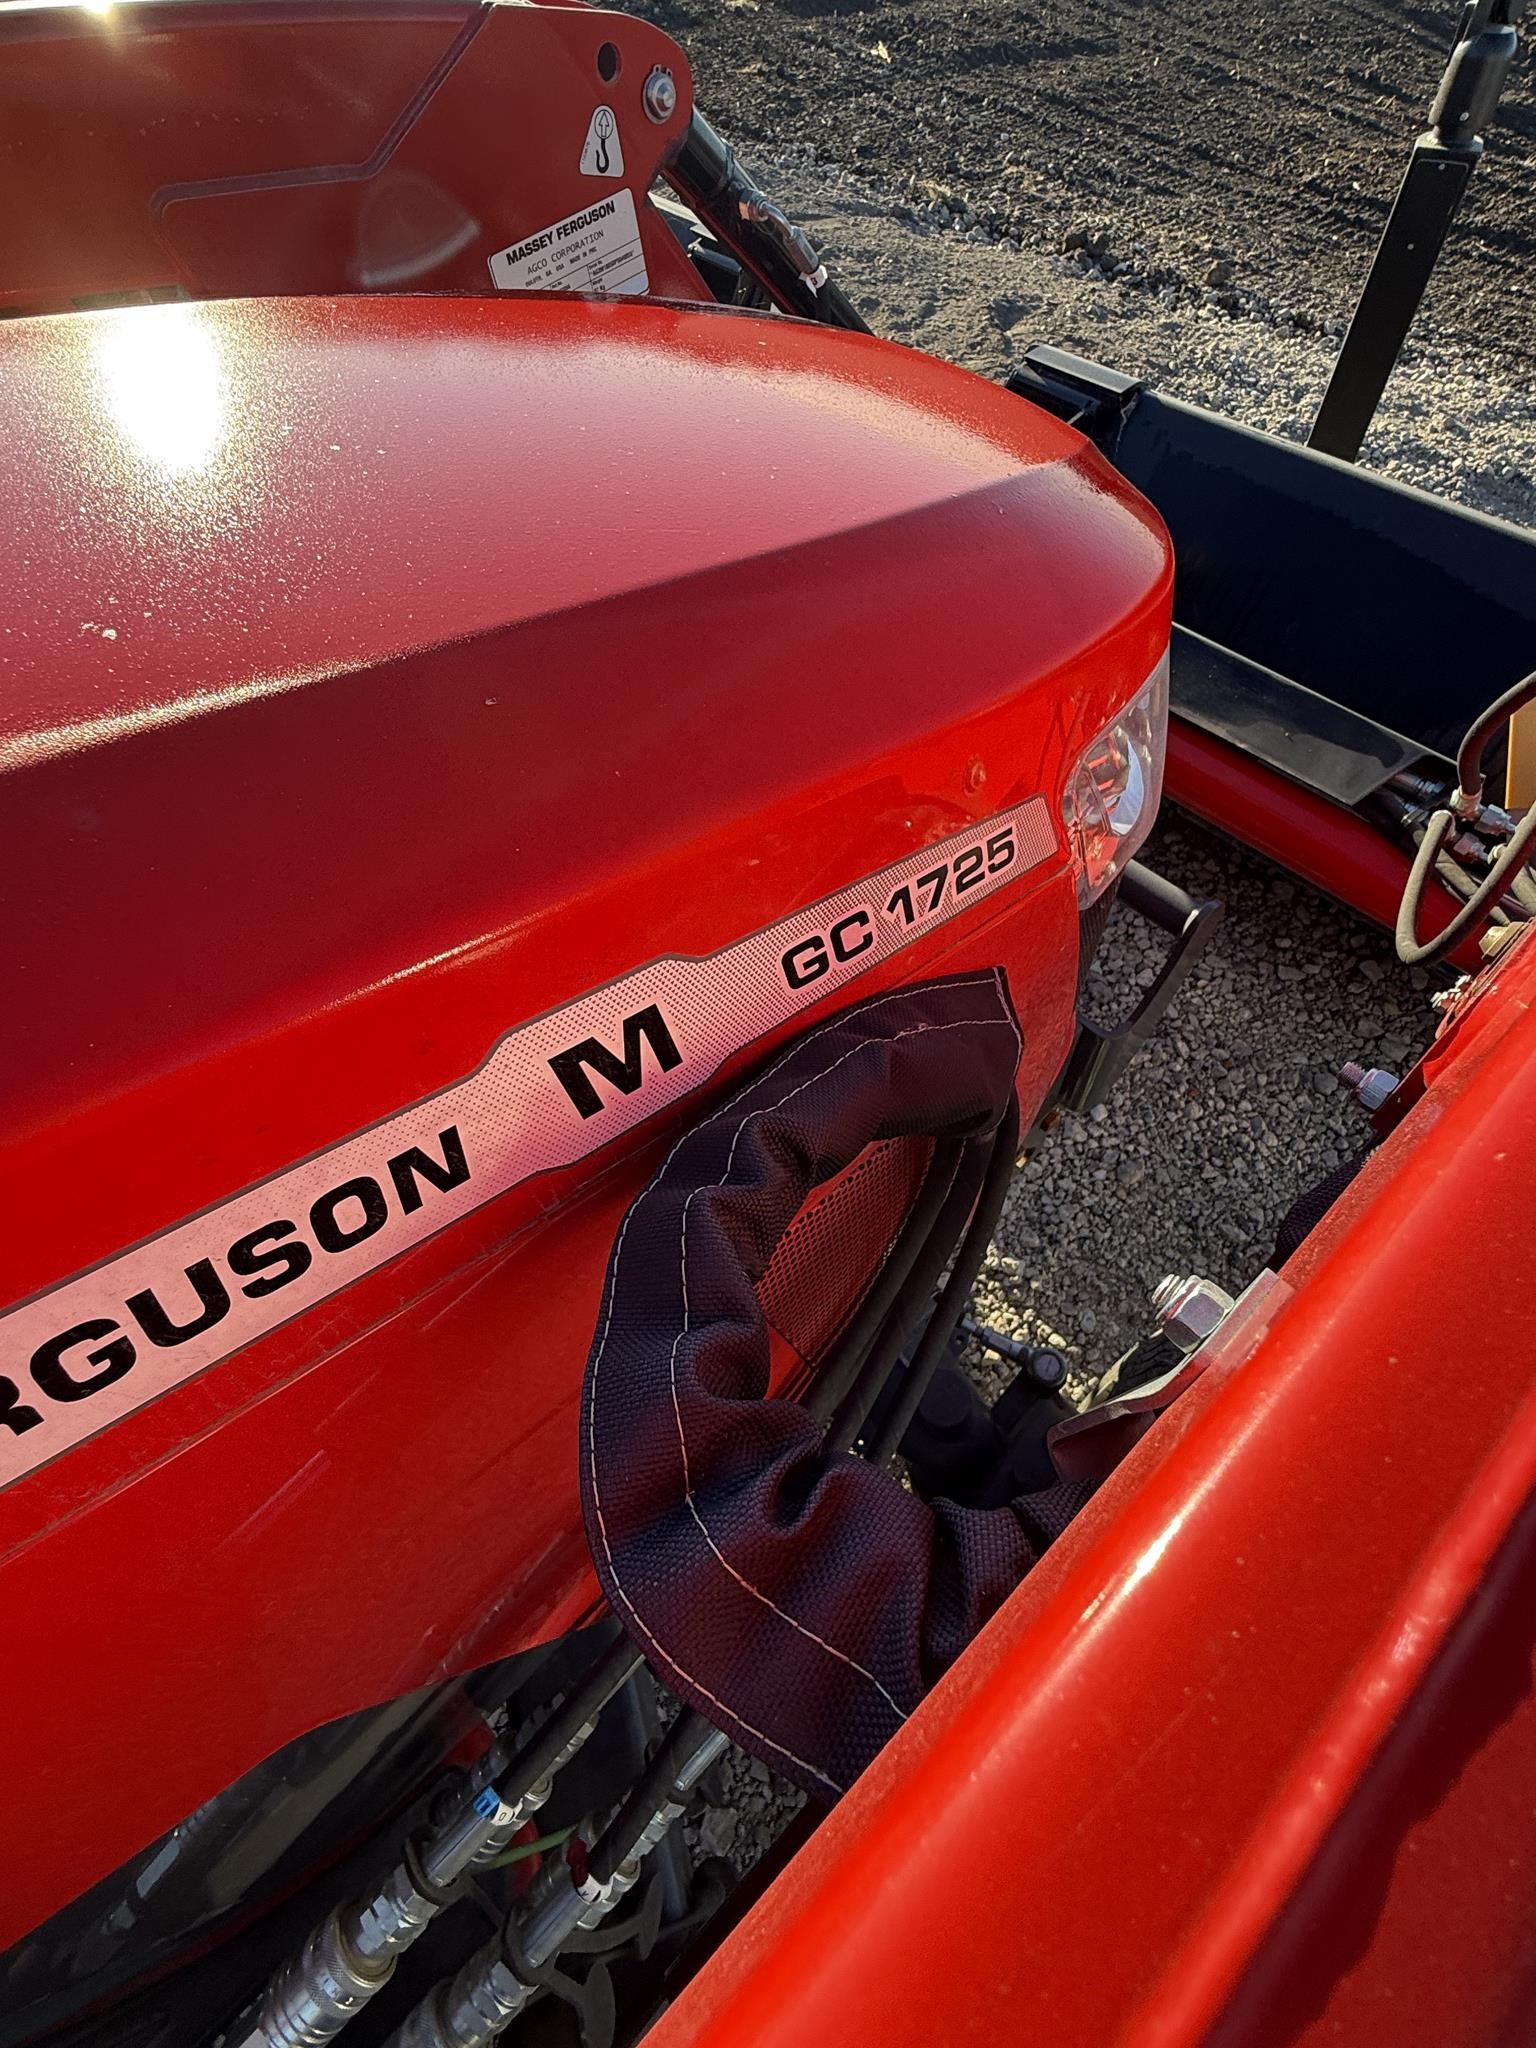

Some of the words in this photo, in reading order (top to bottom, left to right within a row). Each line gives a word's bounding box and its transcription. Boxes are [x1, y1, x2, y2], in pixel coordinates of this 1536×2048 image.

[506, 230, 553, 265] MASSEY
[556, 200, 616, 240] FERGUSON
[527, 258, 548, 275] AGCO
[551, 229, 604, 262] CORPORATION
[781, 910, 874, 990] GC
[887, 827, 1016, 925] 1725
[547, 1003, 683, 1120] M
